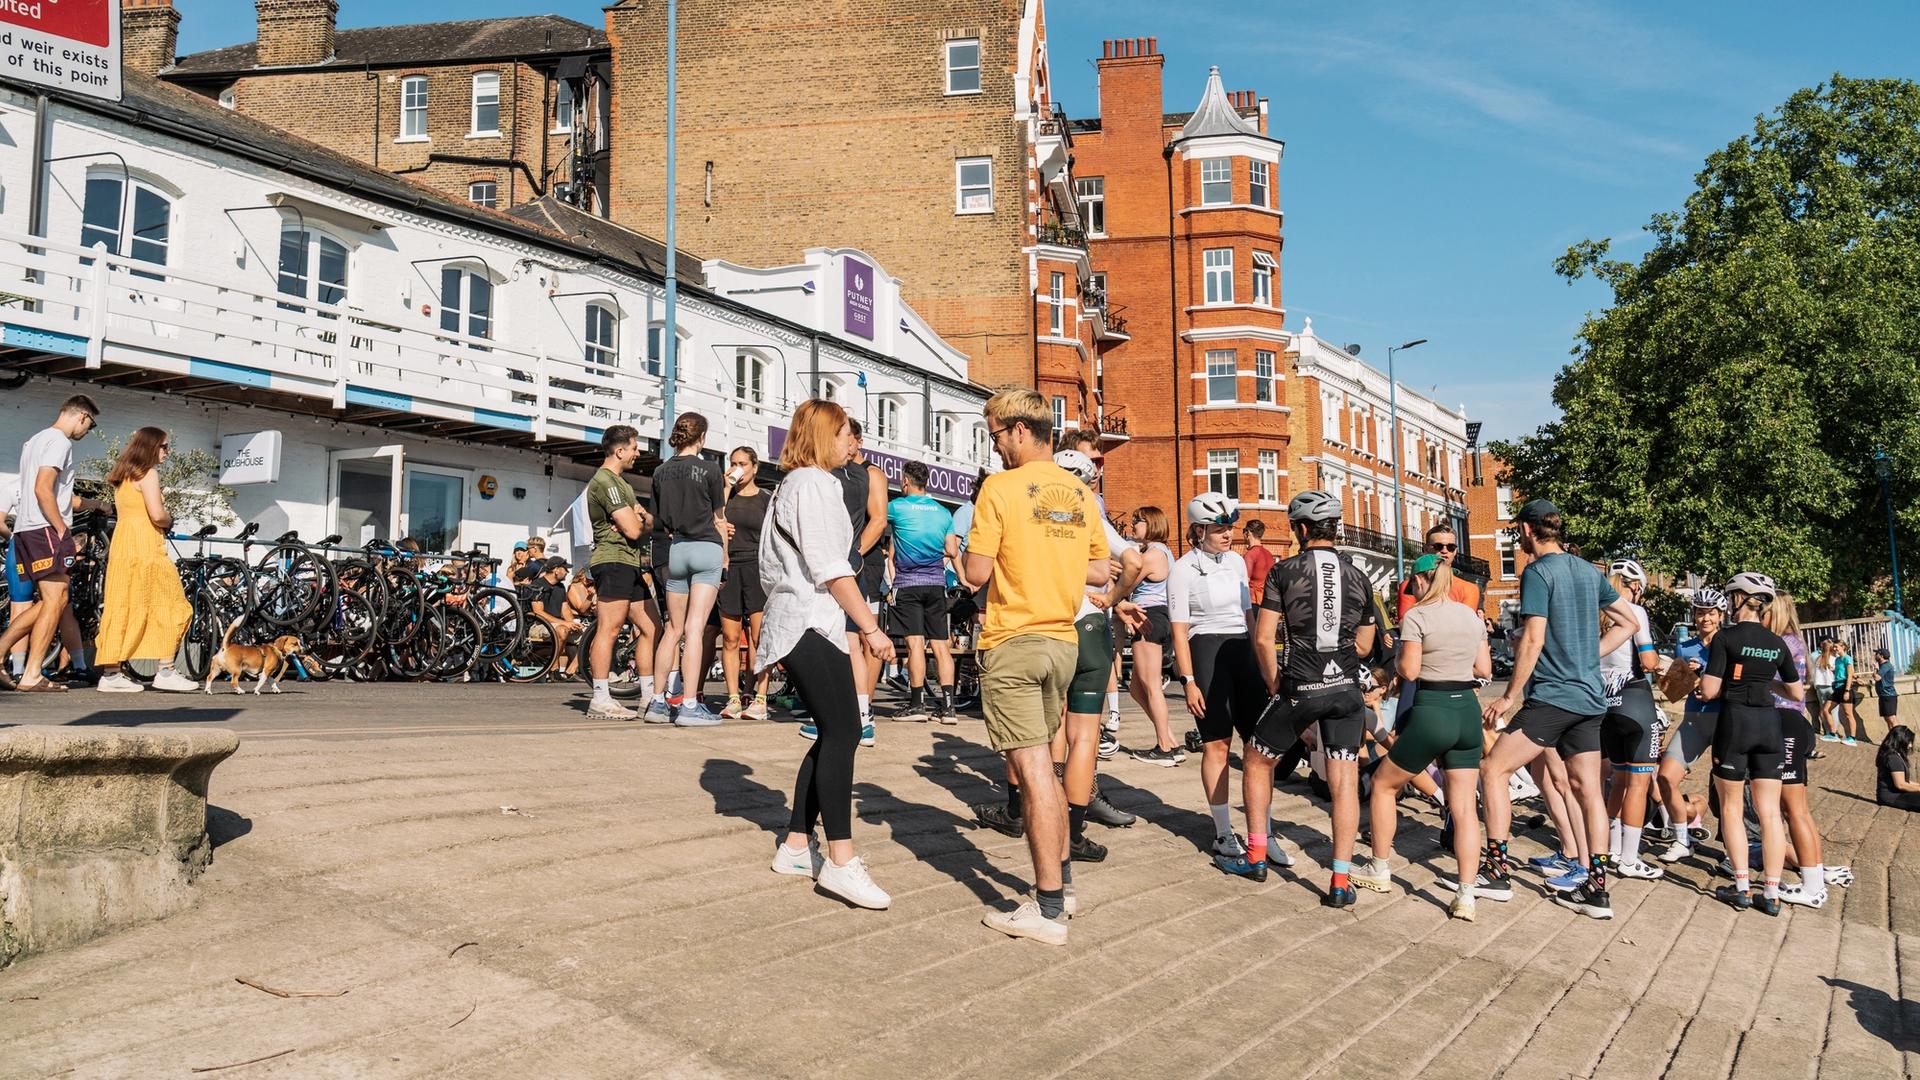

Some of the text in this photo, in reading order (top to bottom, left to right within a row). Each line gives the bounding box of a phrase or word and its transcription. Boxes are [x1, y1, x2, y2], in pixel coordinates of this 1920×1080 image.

[21, 38, 54, 55] weir
[63, 50, 109, 69] exists
[8, 54, 109, 87] of this point
[847, 289, 872, 305] PUTNEY
[223, 456, 264, 469] CLUBHOUSE
[238, 448, 251, 458] THE
[871, 454, 903, 481] HIGH
[1321, 562, 1337, 610] Qhubeka
[1741, 646, 1779, 662] maap
